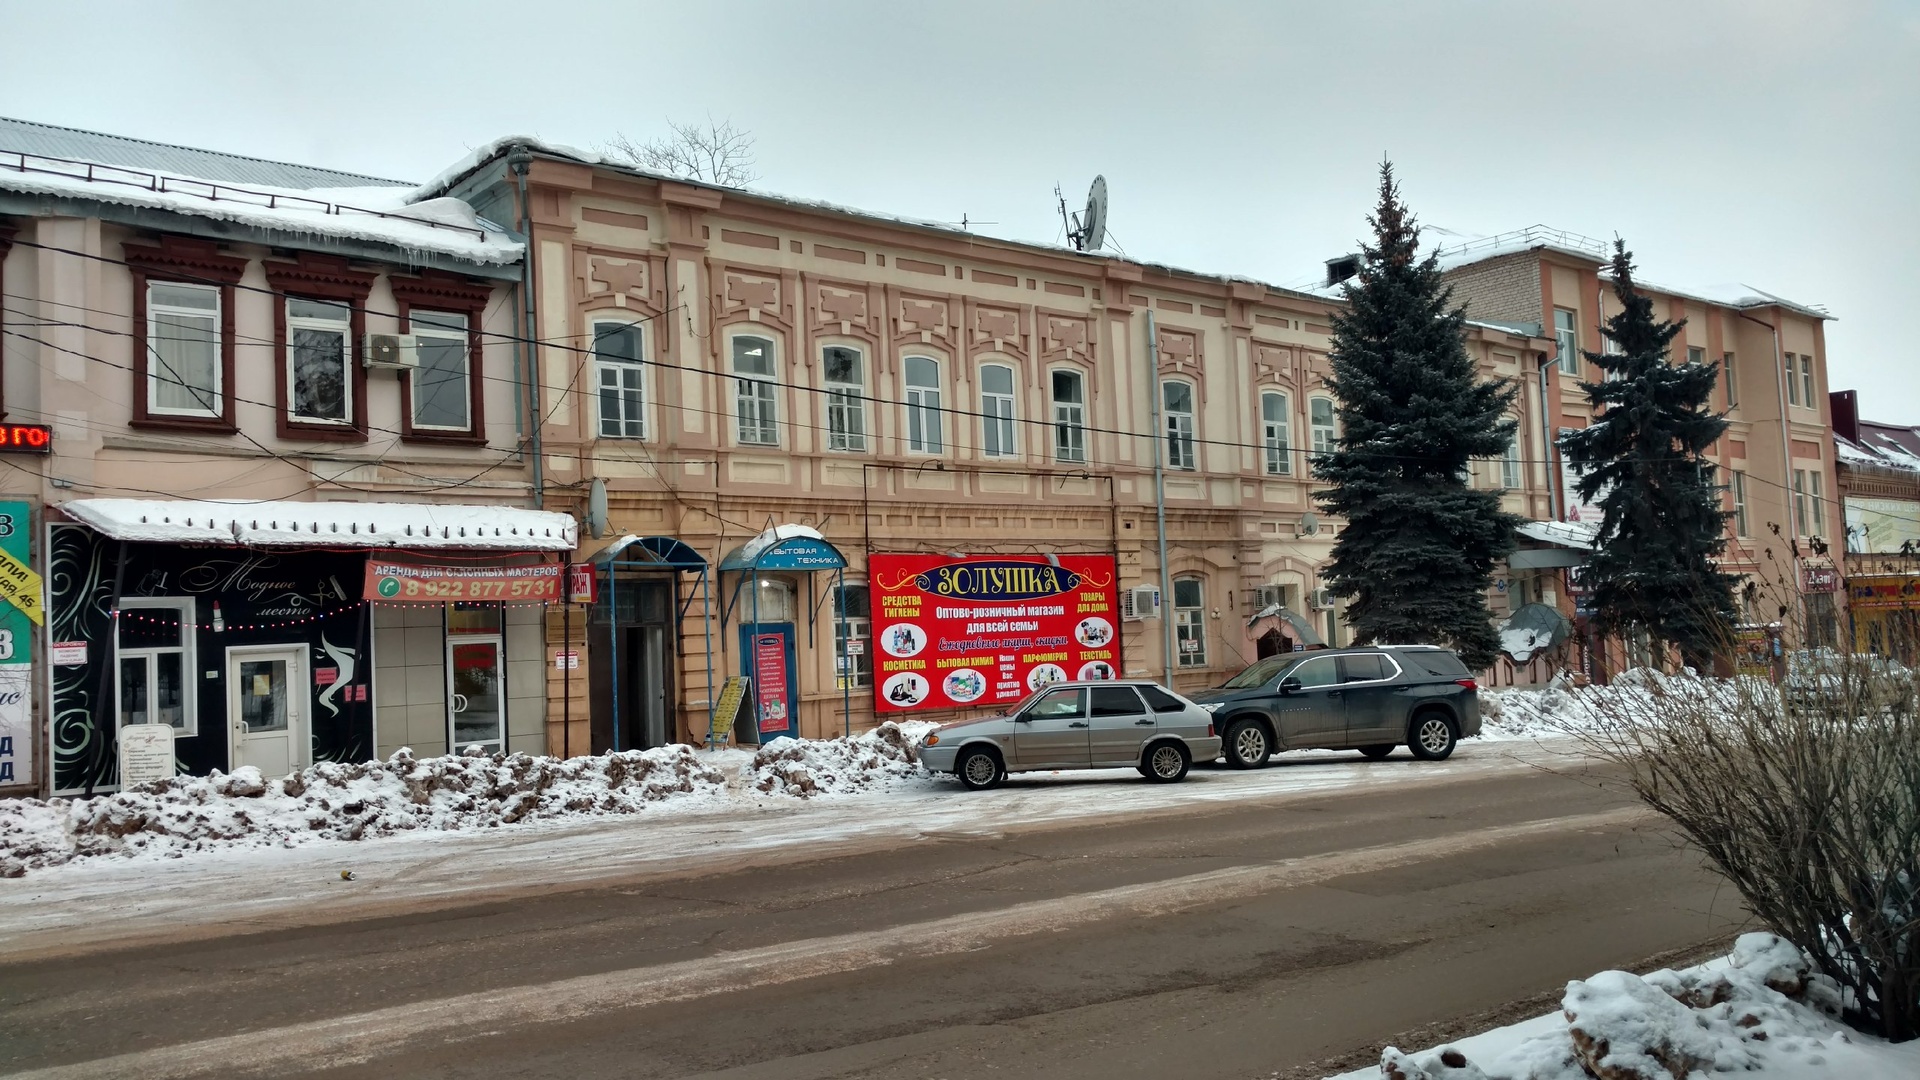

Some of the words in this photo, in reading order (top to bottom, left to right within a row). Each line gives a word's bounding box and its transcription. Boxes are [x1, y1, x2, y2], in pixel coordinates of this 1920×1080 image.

[375, 565, 419, 578] АРЕНДА
[420, 566, 443, 579] ДЛЯ
[446, 566, 504, 578] САЛОННЫХ
[506, 566, 558, 577] МАСТЕРОВ
[179, 555, 296, 602] Модное
[937, 566, 1063, 594] ЗОЛУШКА
[405, 580, 419, 596] 8
[425, 580, 463, 596] 922
[469, 580, 507, 596] 877
[510, 580, 555, 596] 5731
[19, 594, 35, 608] 45
[882, 595, 922, 607] СРЕДСТВА
[1080, 592, 1105, 602] ТОВАРЫ
[256, 607, 312, 616] место
[884, 607, 920, 618] ГИГИЕНЫ
[936, 604, 1026, 619] Оптово-розничный
[1027, 605, 1065, 616] магазин
[1077, 603, 1090, 613] ДЛЯ
[1091, 602, 1109, 613] ДОМА
[966, 622, 985, 635] для
[986, 620, 1009, 633] всей
[1010, 621, 1039, 632] семьи
[938, 636, 1000, 654] Ежедневные
[1002, 637, 1034, 651] акции,
[1035, 636, 1069, 650] скидки
[1023, 652, 1068, 663] ПАРФЮМЕРИЯ
[1080, 650, 1112, 661] ТЕКСТИЛЬ
[883, 660, 926, 671] КОСМЕТИКА
[936, 657, 970, 668] БЫТОВАЯ
[970, 656, 994, 667] ХИМИЯ
[1002, 672, 1013, 680] Вас
[996, 681, 1020, 690] приятно
